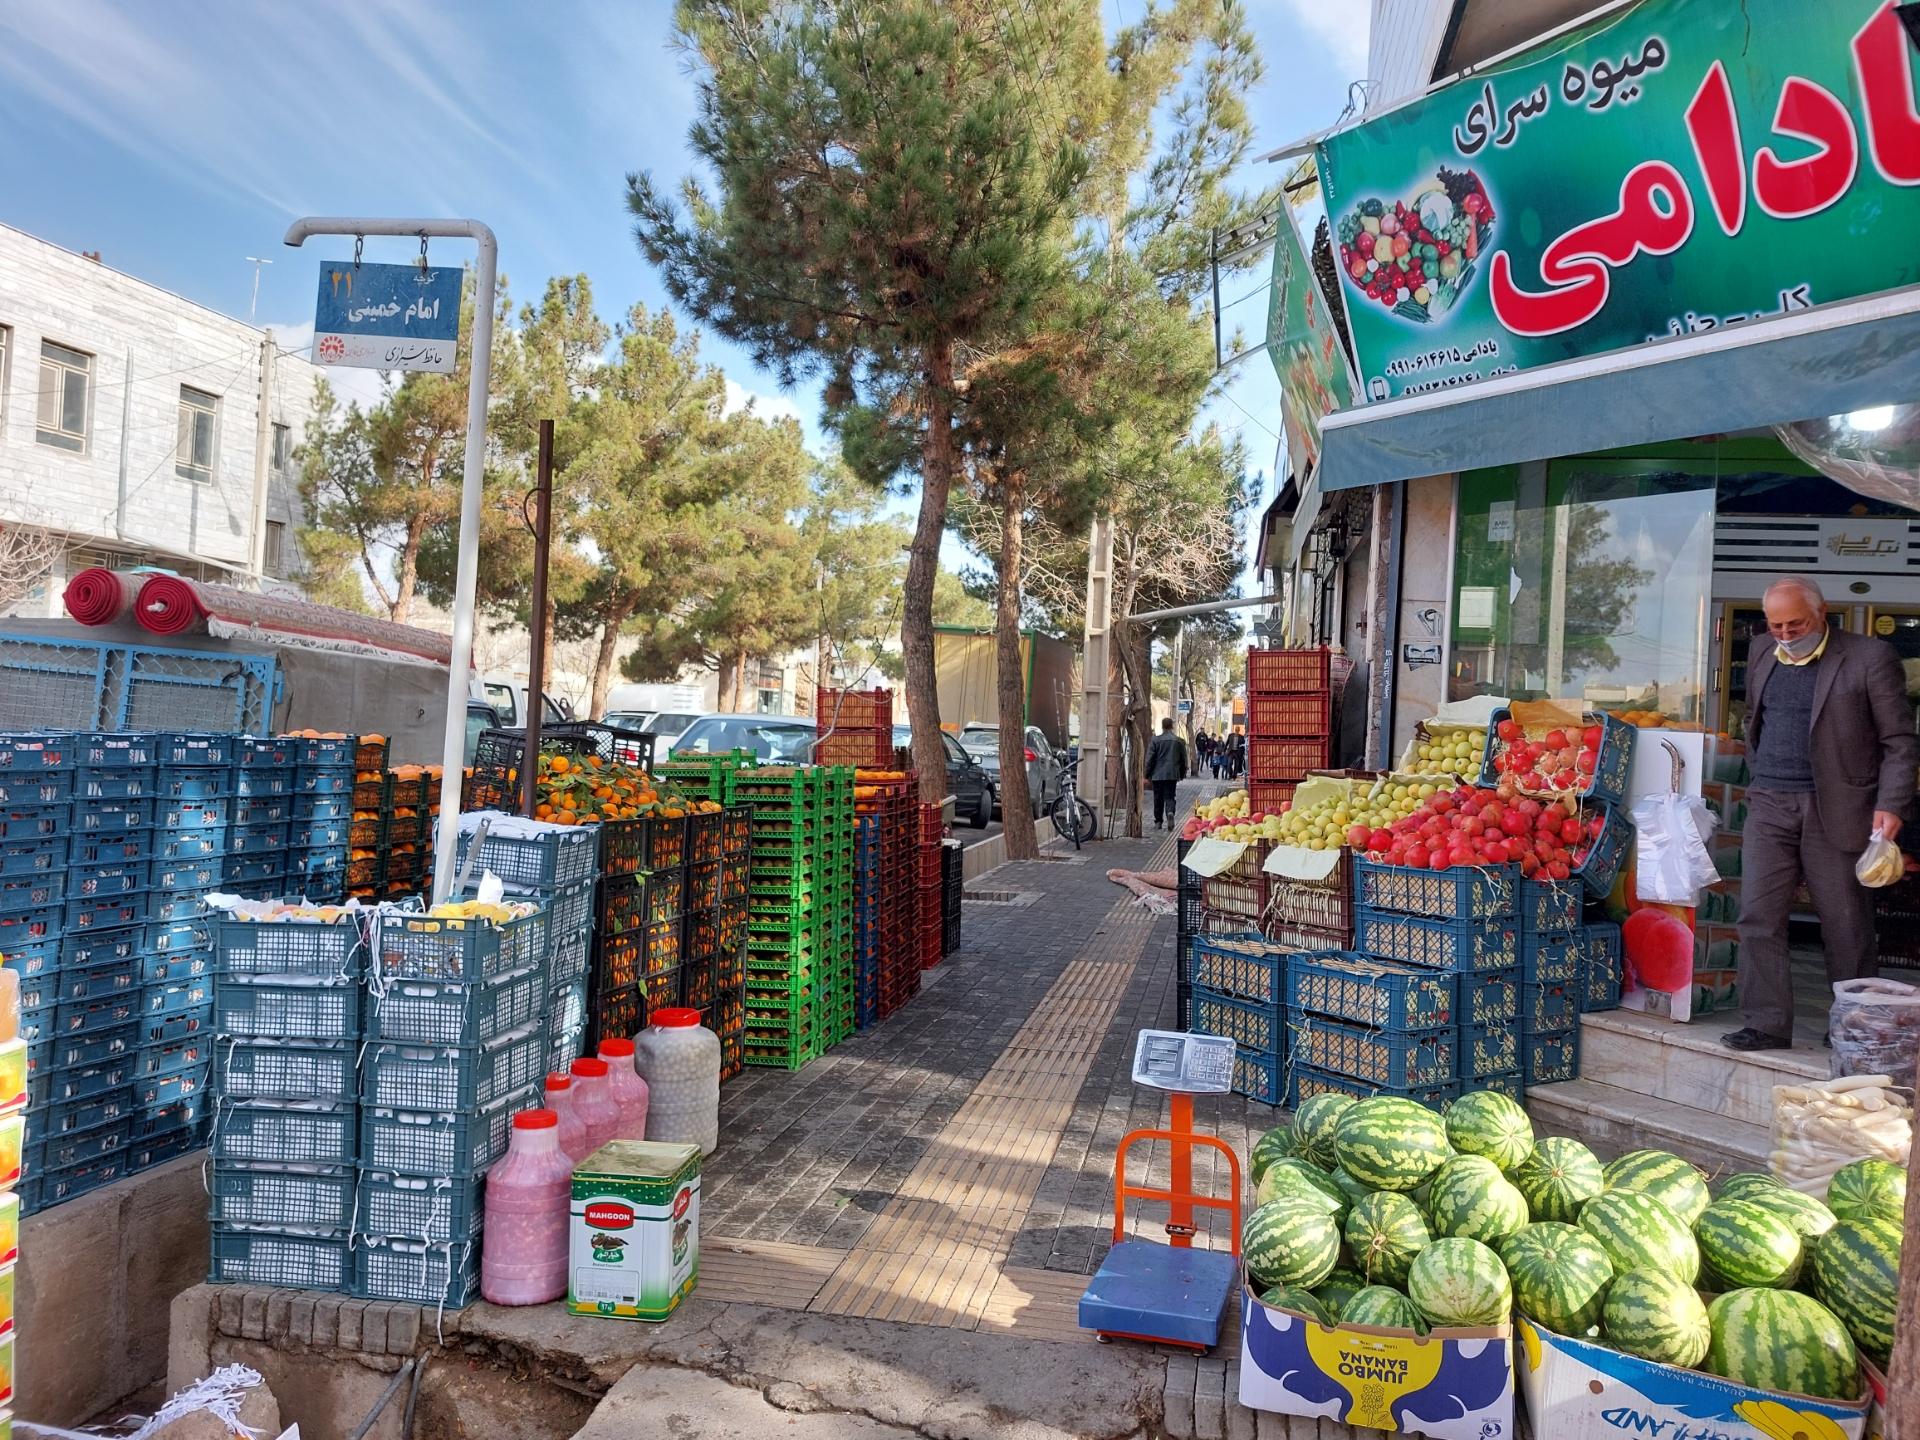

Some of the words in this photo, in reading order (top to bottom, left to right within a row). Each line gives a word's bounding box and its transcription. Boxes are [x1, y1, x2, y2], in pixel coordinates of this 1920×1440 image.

[1564, 35, 1667, 108] میوه
[1454, 82, 1549, 155] سرای
[1489, 0, 1920, 336] ادامی
[348, 295, 401, 323] خمینی
[404, 297, 440, 325] امام
[384, 344, 427, 368] شیرازی
[421, 346, 443, 364] حافظ
[1463, 340, 1498, 363] بادامی
[588, 1211, 631, 1222] MAHGOON
[1339, 1350, 1408, 1370] BANANA
[1338, 1362, 1408, 1385] JUMBO
[1645, 1365, 1695, 1385] BANANAS
[1699, 1379, 1746, 1398] QUALITY
